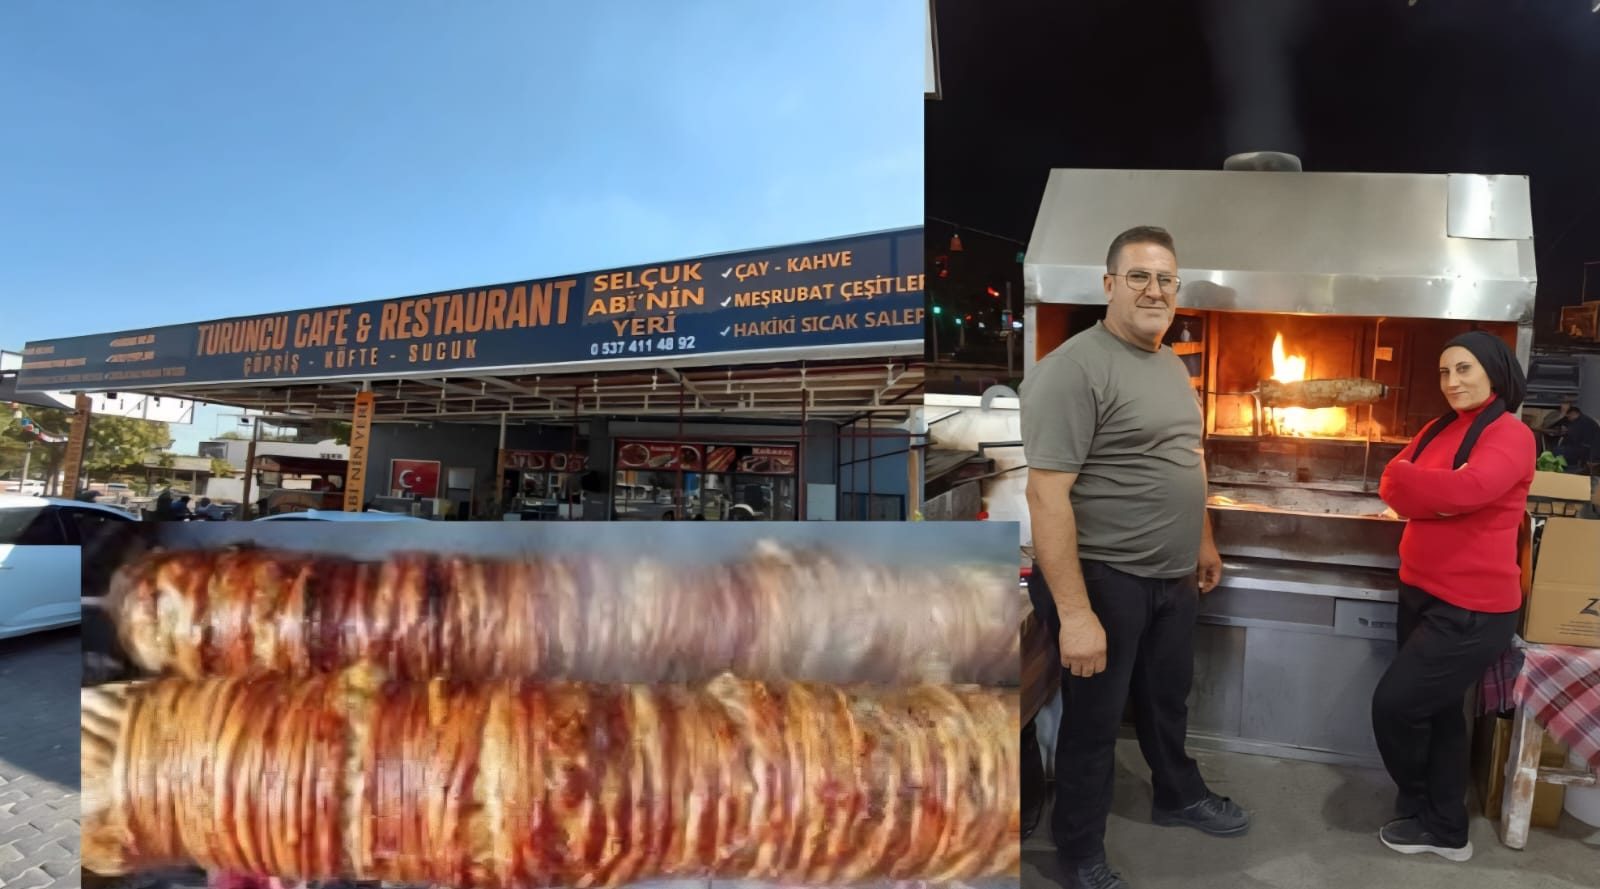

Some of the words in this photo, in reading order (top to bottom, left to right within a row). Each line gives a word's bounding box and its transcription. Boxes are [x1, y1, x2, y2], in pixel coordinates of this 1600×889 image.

[593, 263, 702, 291] SELÇUK
[735, 261, 769, 282] ÇAY
[787, 251, 852, 273] KAHVE
[735, 283, 835, 309] MEŞRUBAT
[197, 315, 289, 356] TURUNCU
[294, 307, 352, 349] CAFE
[356, 312, 372, 343] &
[379, 279, 577, 341] RESTAURANT
[613, 311, 677, 337] YERİ
[801, 313, 858, 333] SICAK
[324, 345, 379, 369] KÖFTE
[408, 339, 477, 363] SUCUK
[591, 343, 599, 356] 0
[602, 341, 625, 355] 537
[628, 339, 652, 352] 411
[678, 335, 696, 350] 92
